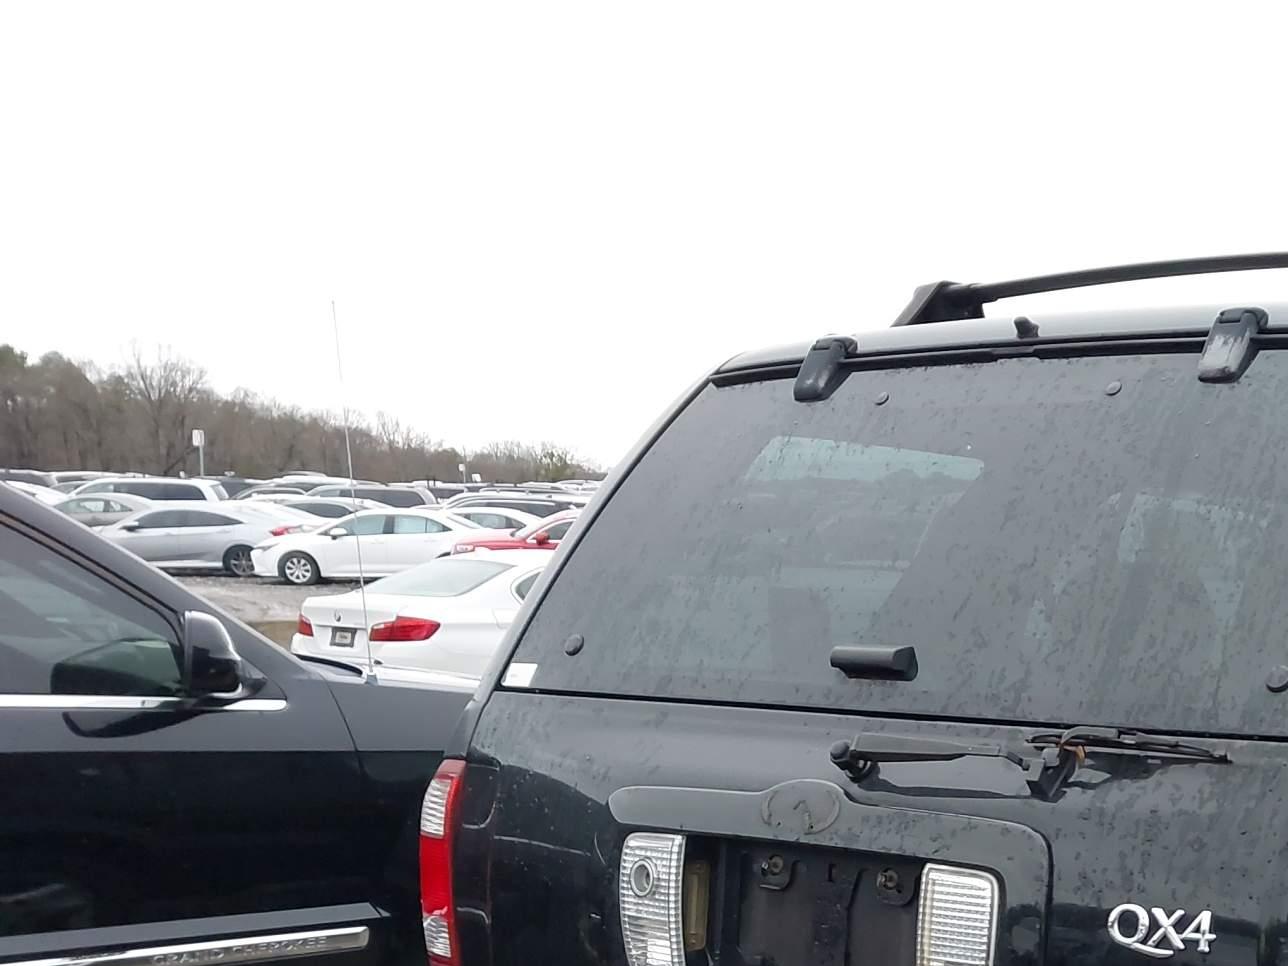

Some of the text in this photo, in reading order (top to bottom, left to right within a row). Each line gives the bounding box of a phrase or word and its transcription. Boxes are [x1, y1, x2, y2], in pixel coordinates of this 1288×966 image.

[153, 936, 328, 966] GRAND CHEROKEE
[1107, 903, 1217, 958] QX4
